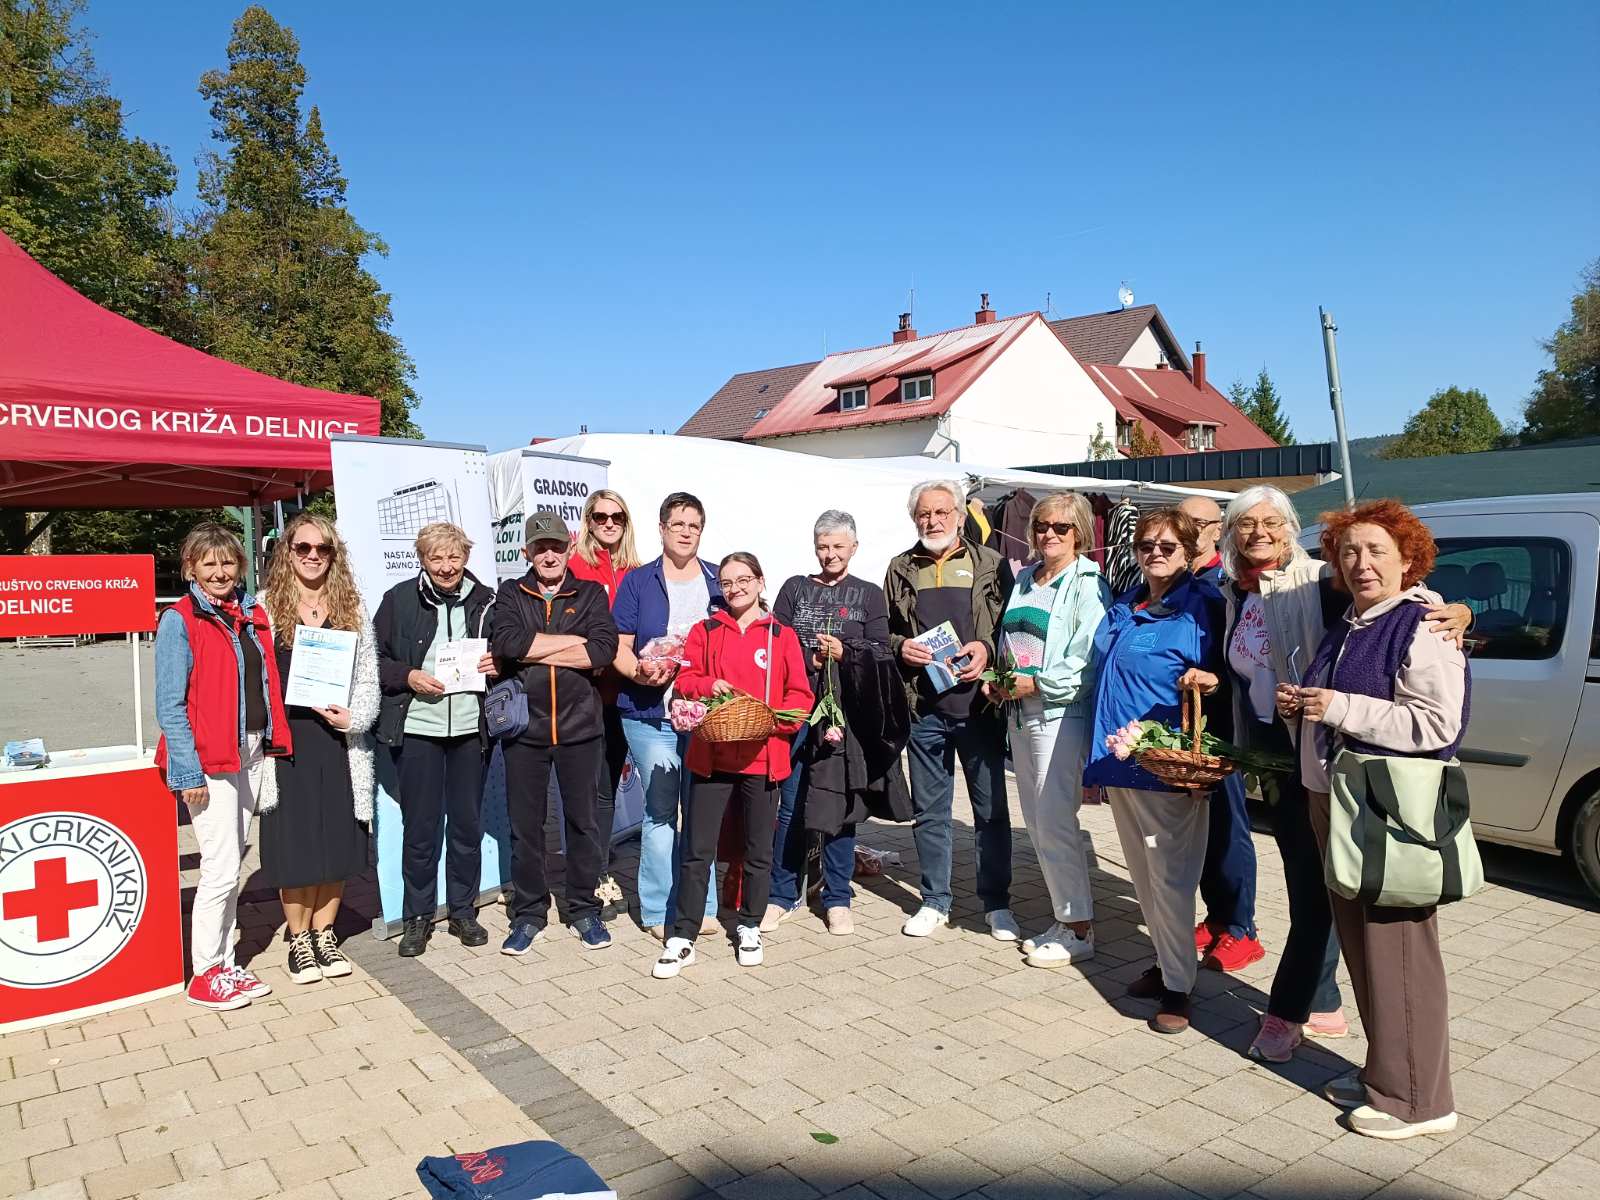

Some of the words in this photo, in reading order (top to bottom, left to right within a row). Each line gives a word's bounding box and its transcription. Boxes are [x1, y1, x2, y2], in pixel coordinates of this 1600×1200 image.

[151, 408, 237, 435] KRIŽA
[245, 415, 359, 440] DELNICE
[533, 478, 589, 498] GRADSKO
[385, 560, 414, 570] JAVNO
[0, 578, 43, 591] UŠTVO
[45, 579, 102, 590] CRVENOG
[105, 577, 139, 589] KRIŽA
[29, 820, 131, 868] CRVENI
[105, 869, 138, 933] KRIŽ
